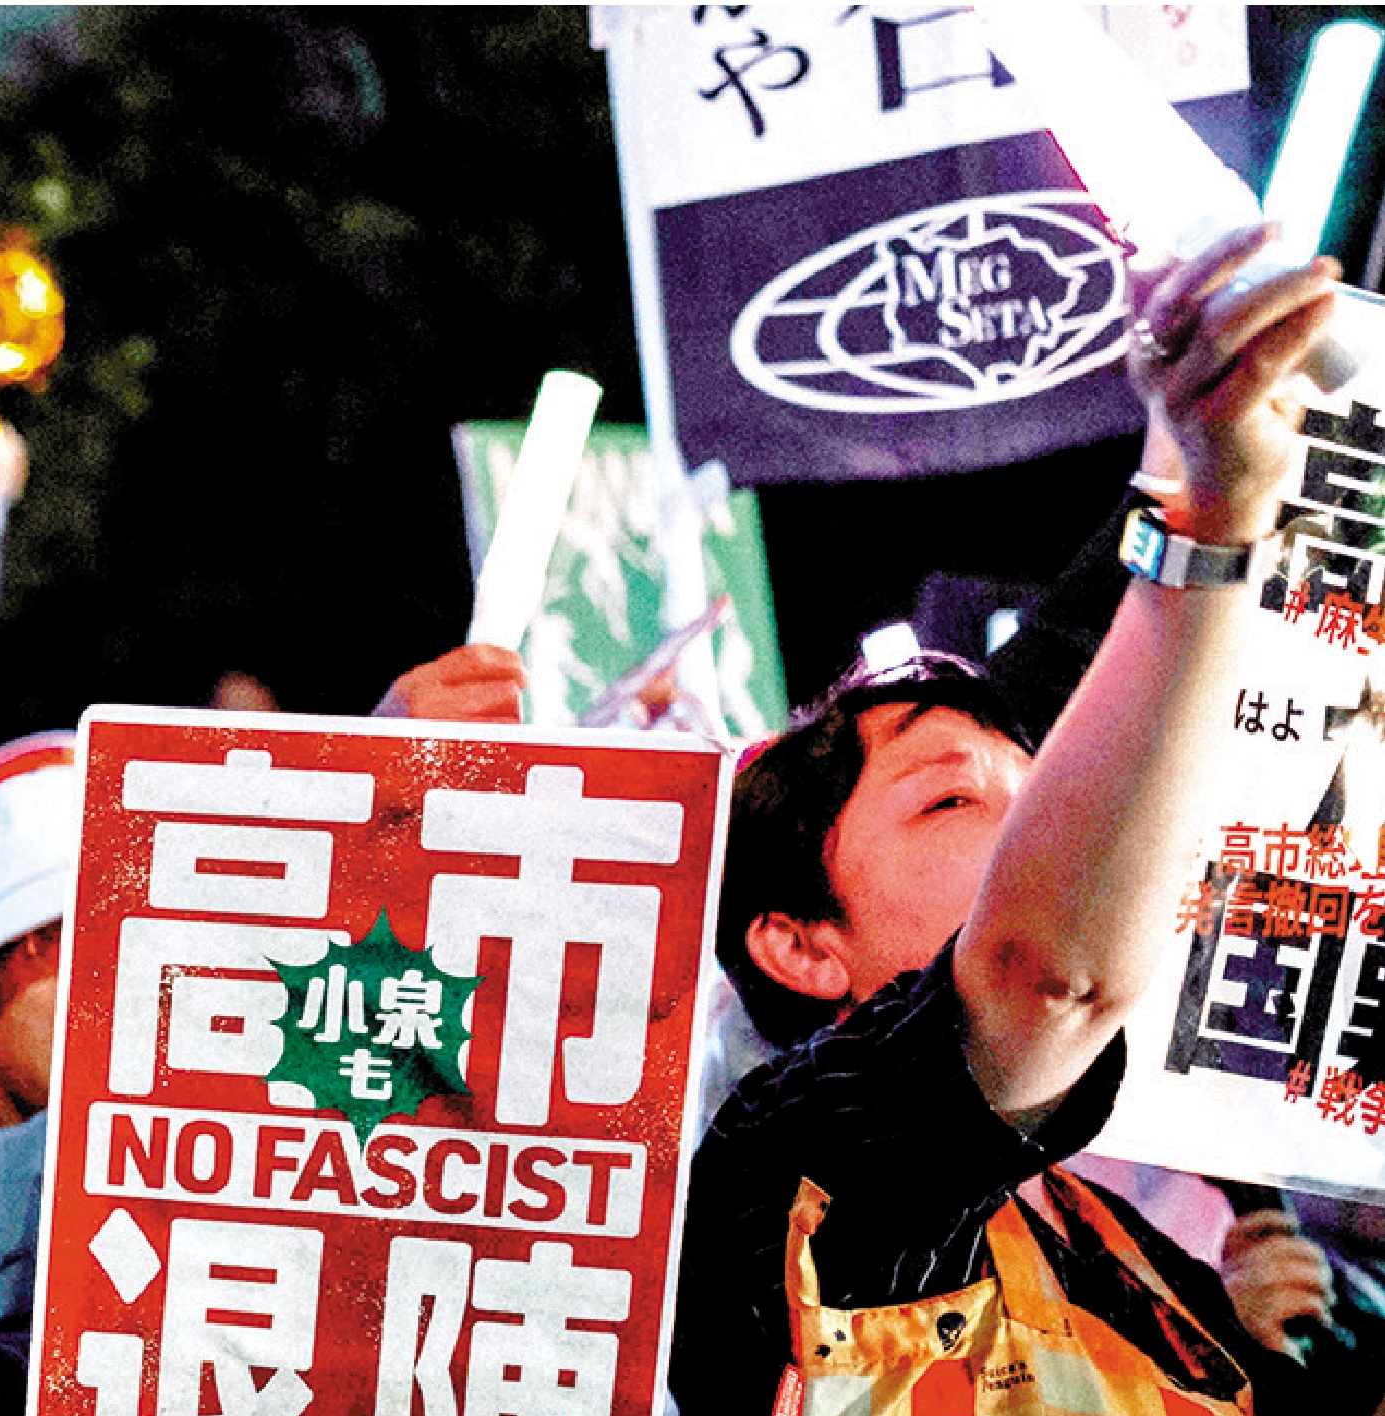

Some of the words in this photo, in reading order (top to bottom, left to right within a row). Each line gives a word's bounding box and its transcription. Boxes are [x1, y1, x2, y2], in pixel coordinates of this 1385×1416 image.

[901, 248, 1012, 308] MEG
[938, 295, 1051, 348] SETA
[109, 748, 685, 1127] 高市
[297, 963, 446, 1054] 小泉
[338, 1047, 395, 1102] も
[106, 1112, 234, 1198] NO
[251, 1122, 633, 1228] FASCIST
